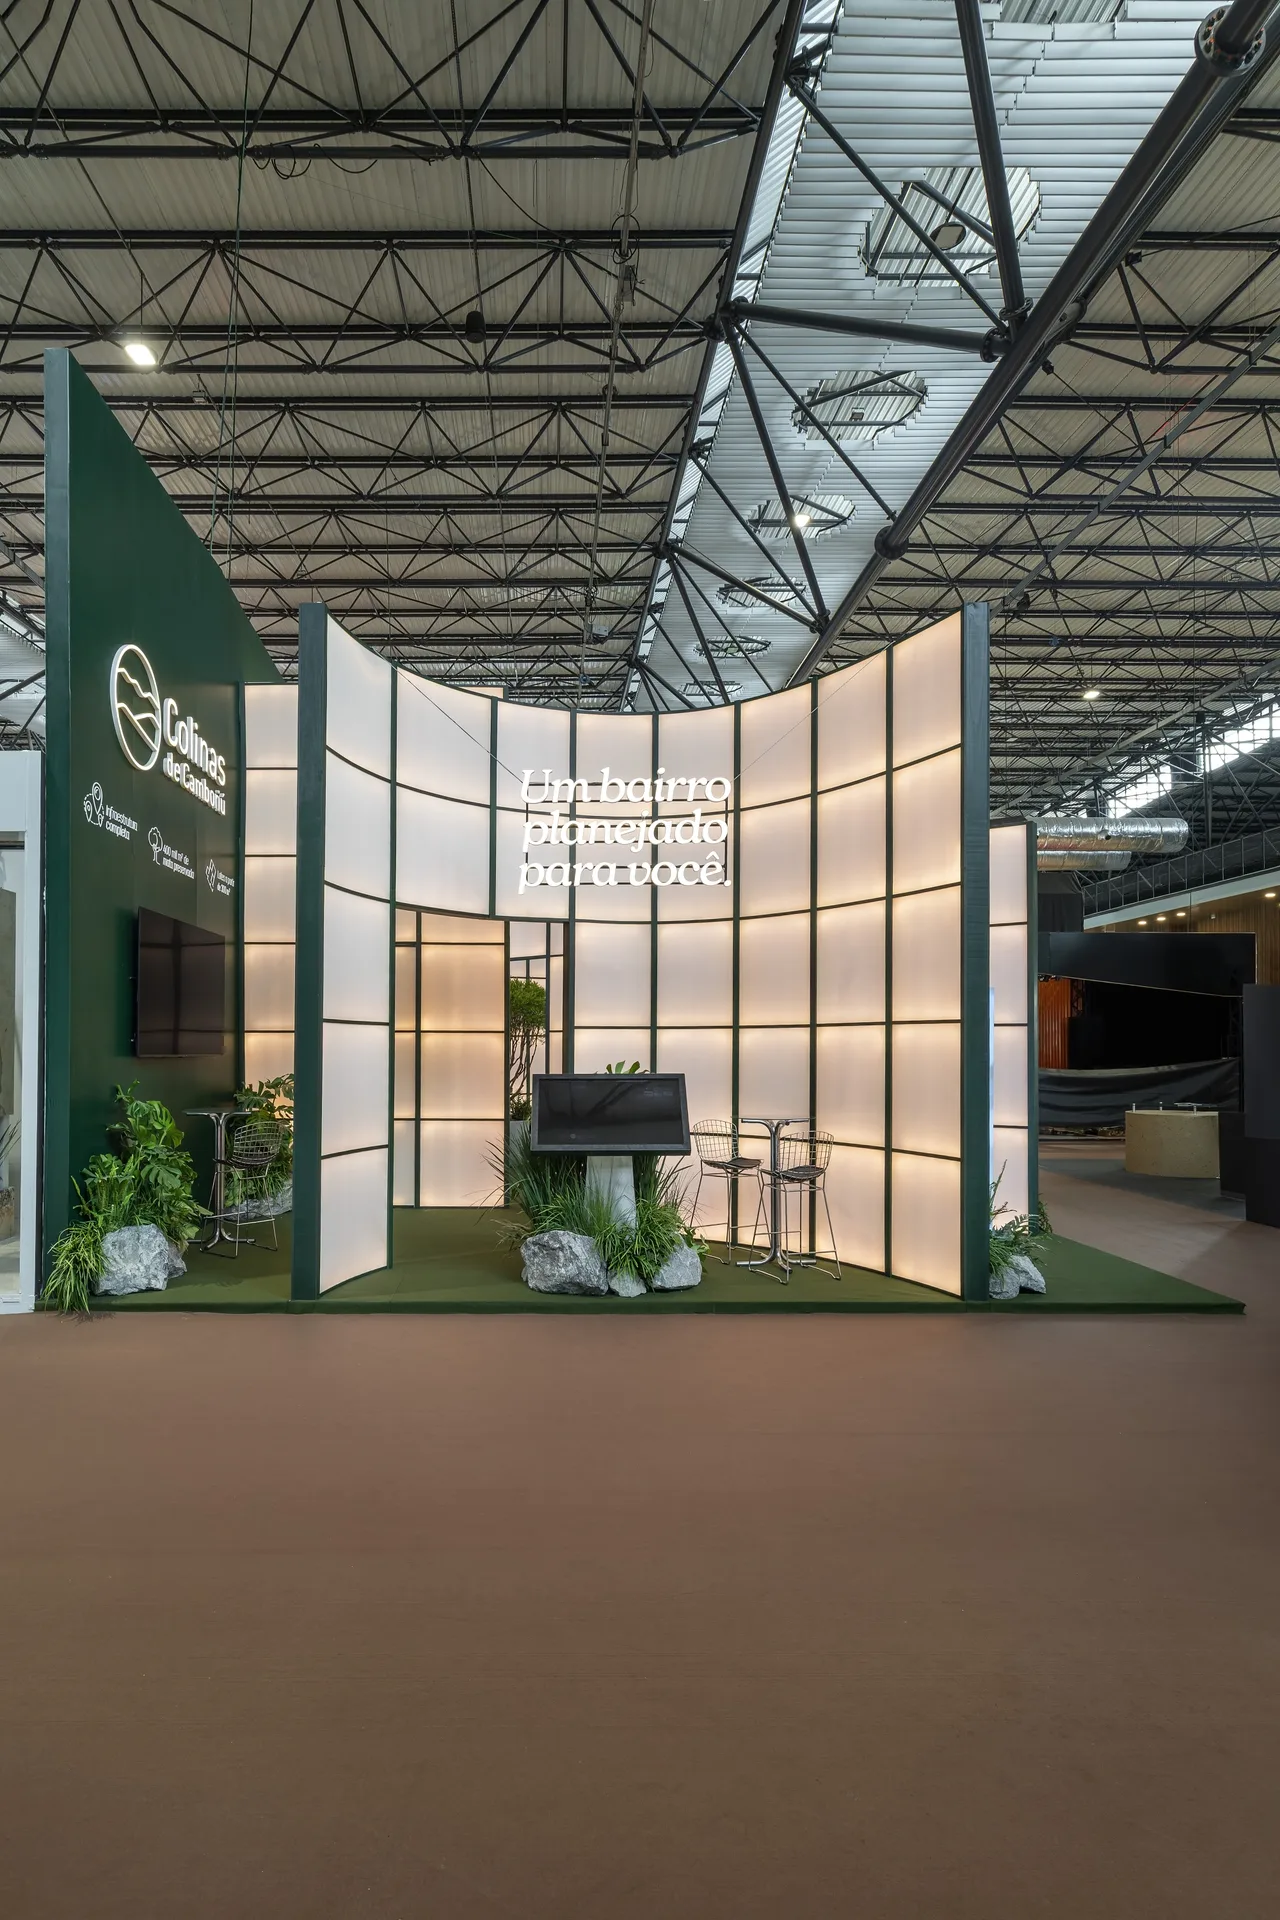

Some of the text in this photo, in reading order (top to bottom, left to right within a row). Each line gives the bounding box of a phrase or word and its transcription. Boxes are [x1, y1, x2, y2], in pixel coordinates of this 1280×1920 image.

[163, 698, 226, 786] Colinas
[163, 752, 226, 815] de Camboriú
[520, 767, 731, 804] Um bairro
[106, 805, 137, 831] Infraestrutura
[106, 821, 130, 840] completa
[522, 808, 729, 853] planejado
[518, 851, 732, 895] para você.
